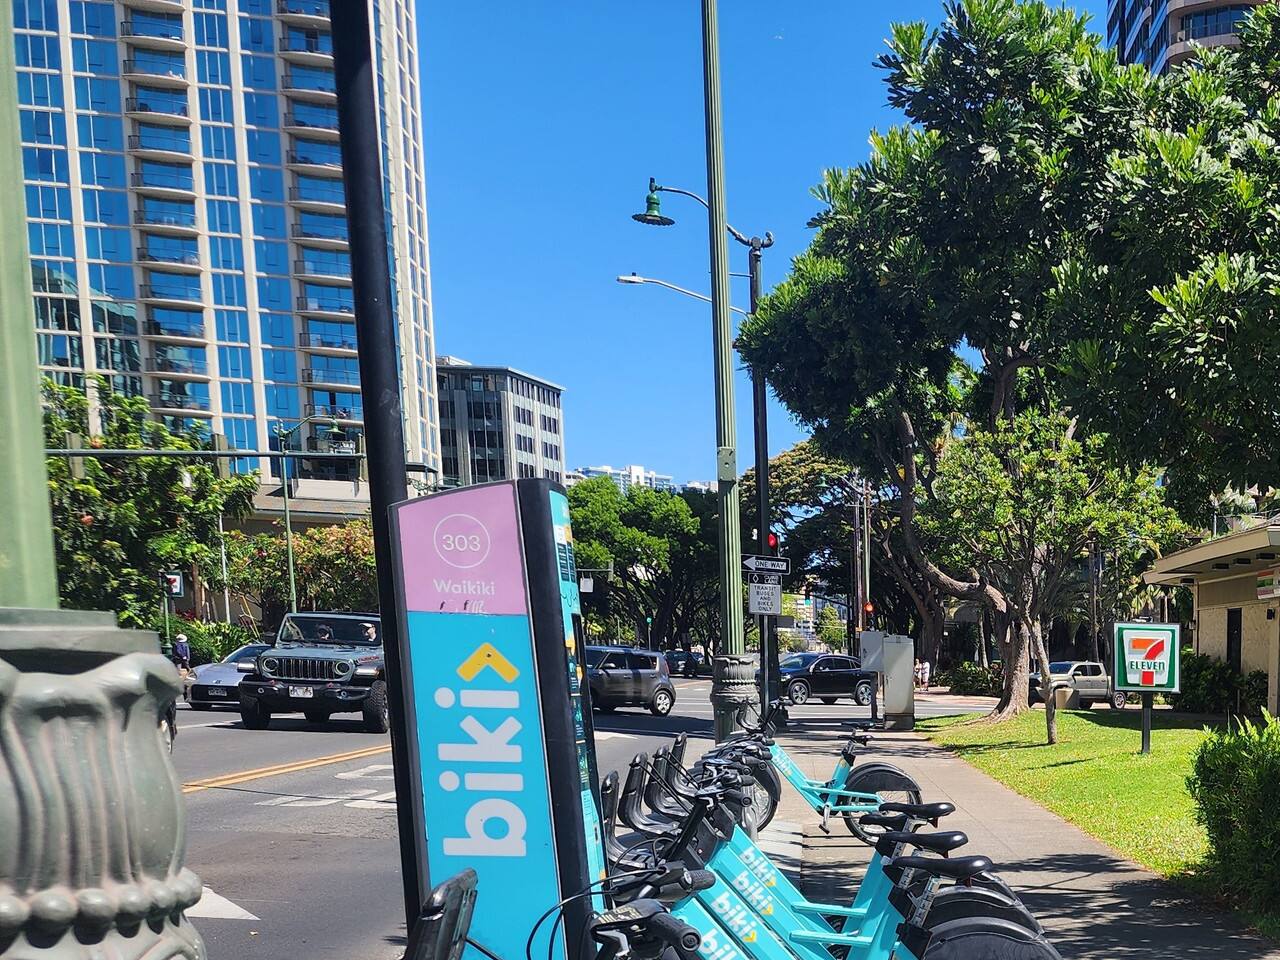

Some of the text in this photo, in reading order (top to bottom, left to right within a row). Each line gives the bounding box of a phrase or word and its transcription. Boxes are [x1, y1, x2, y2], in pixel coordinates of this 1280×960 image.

[442, 534, 481, 551] 303
[433, 578, 495, 595] Waikiki
[434, 687, 527, 856] biki
[739, 847, 776, 883] biki
[733, 870, 773, 912] biki
[711, 891, 757, 938] biki
